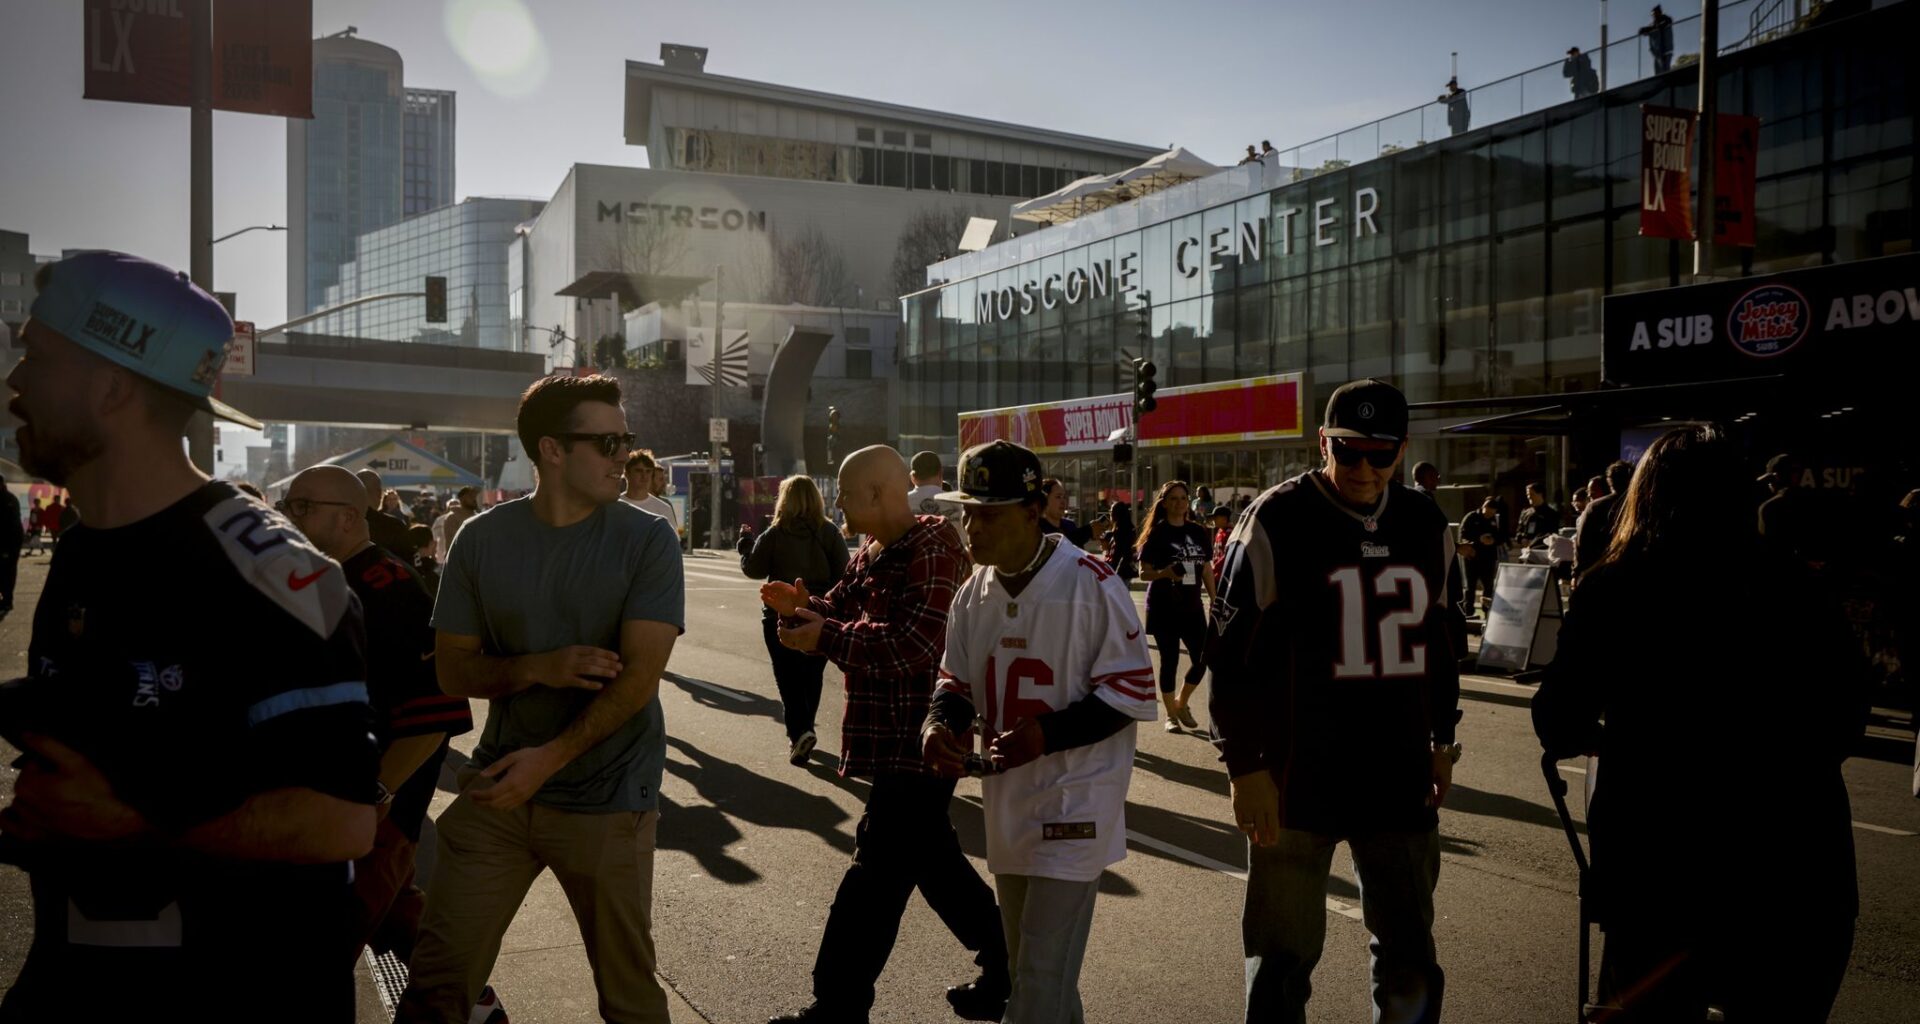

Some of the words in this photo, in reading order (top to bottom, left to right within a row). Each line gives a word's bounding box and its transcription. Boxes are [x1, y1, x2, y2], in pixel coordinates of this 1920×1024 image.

[91, 8, 136, 74] LX
[1645, 114, 1688, 144] SUPER
[1652, 142, 1687, 172] BOWL
[1643, 168, 1666, 212] LX
[597, 200, 766, 232] METREON
[976, 251, 1138, 326] MOSCONE
[1176, 186, 1381, 279] CENTER
[1737, 299, 1800, 322] Jersey
[119, 318, 157, 354] LX
[1629, 320, 1652, 351] A
[1656, 314, 1714, 349] SUB
[1064, 410, 1094, 440] SUPER
[389, 458, 409, 471] EXIT
[1326, 562, 1430, 681] 12
